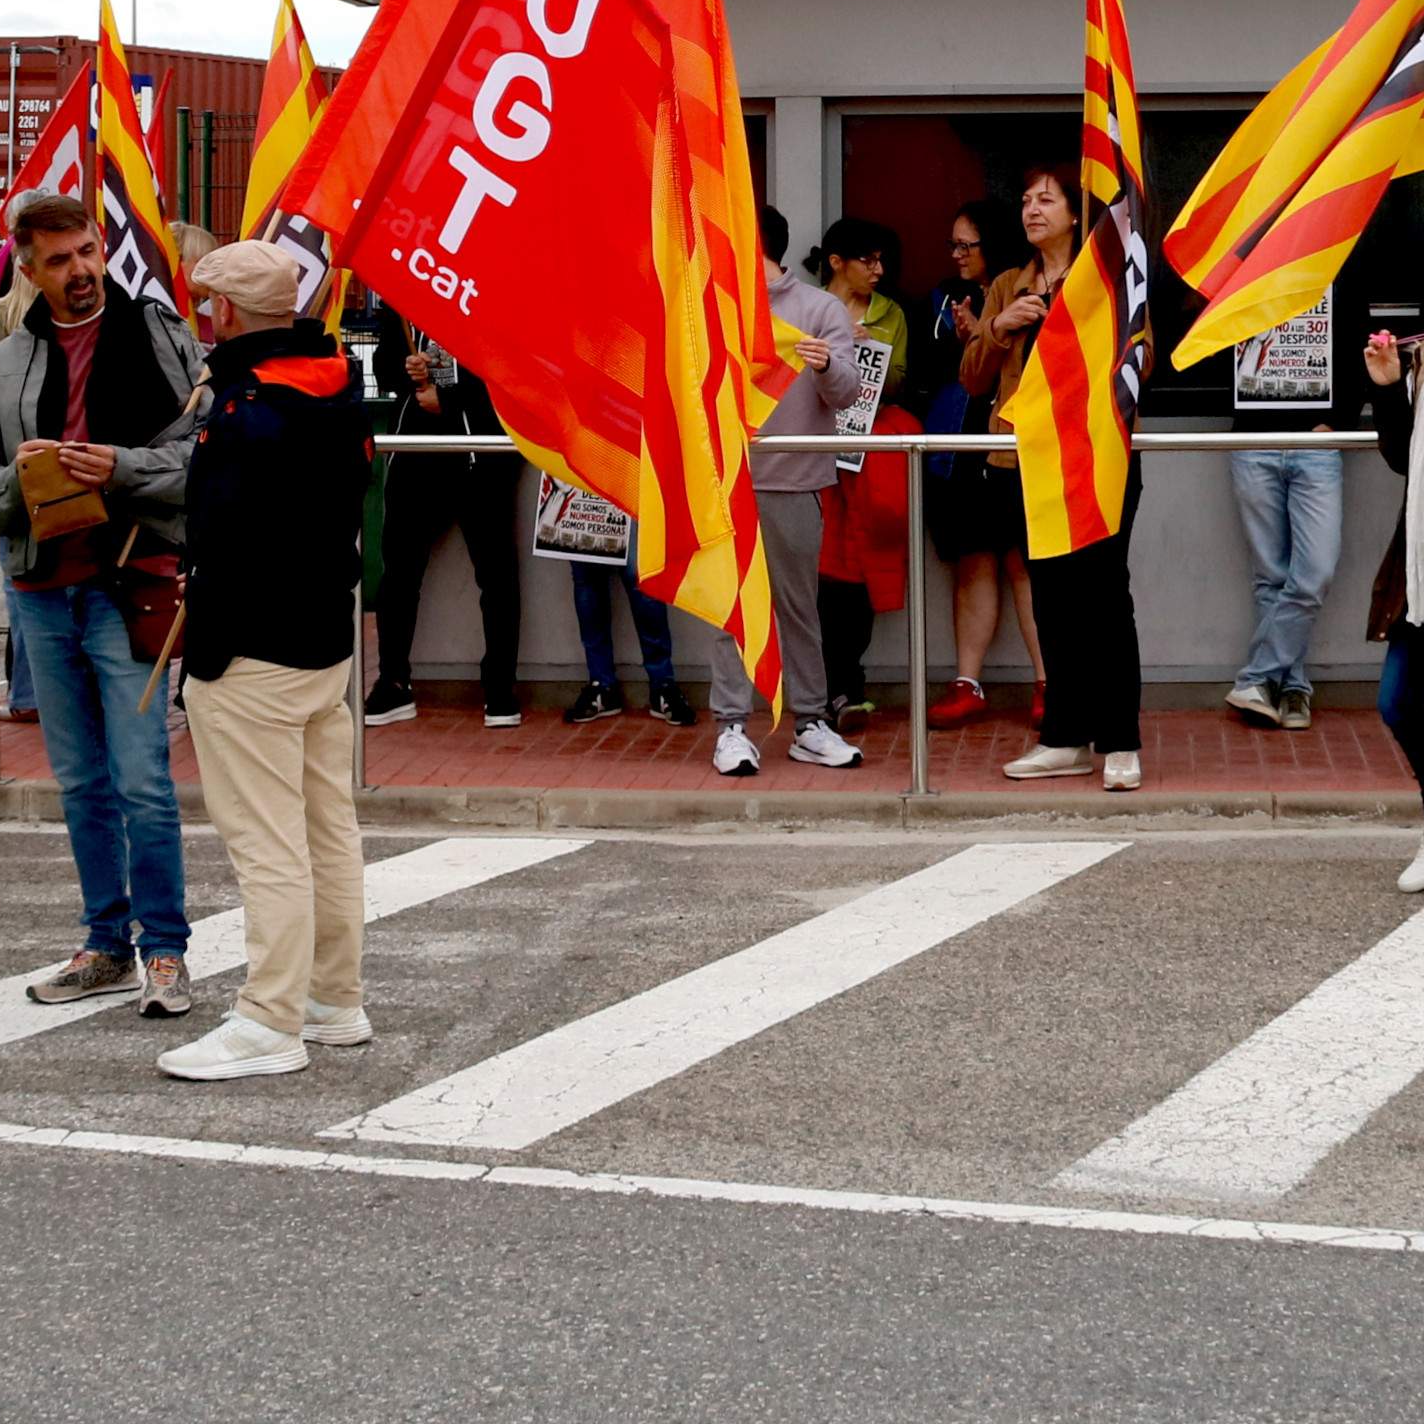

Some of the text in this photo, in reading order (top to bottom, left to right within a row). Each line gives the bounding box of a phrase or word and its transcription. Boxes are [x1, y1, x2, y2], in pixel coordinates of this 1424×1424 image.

[18, 115, 39, 129] 22G1
[391, 248, 479, 316] .cat
[1307, 320, 1328, 334] 301
[1280, 334, 1328, 345] DESPIDOS
[854, 345, 884, 368] RE
[1269, 349, 1307, 358] NO SOMOS
[1262, 368, 1328, 378] SOMOS PERSONAS
[570, 502, 607, 514] NO SOMOS
[561, 520, 625, 535] SOMOS PERSONAS
